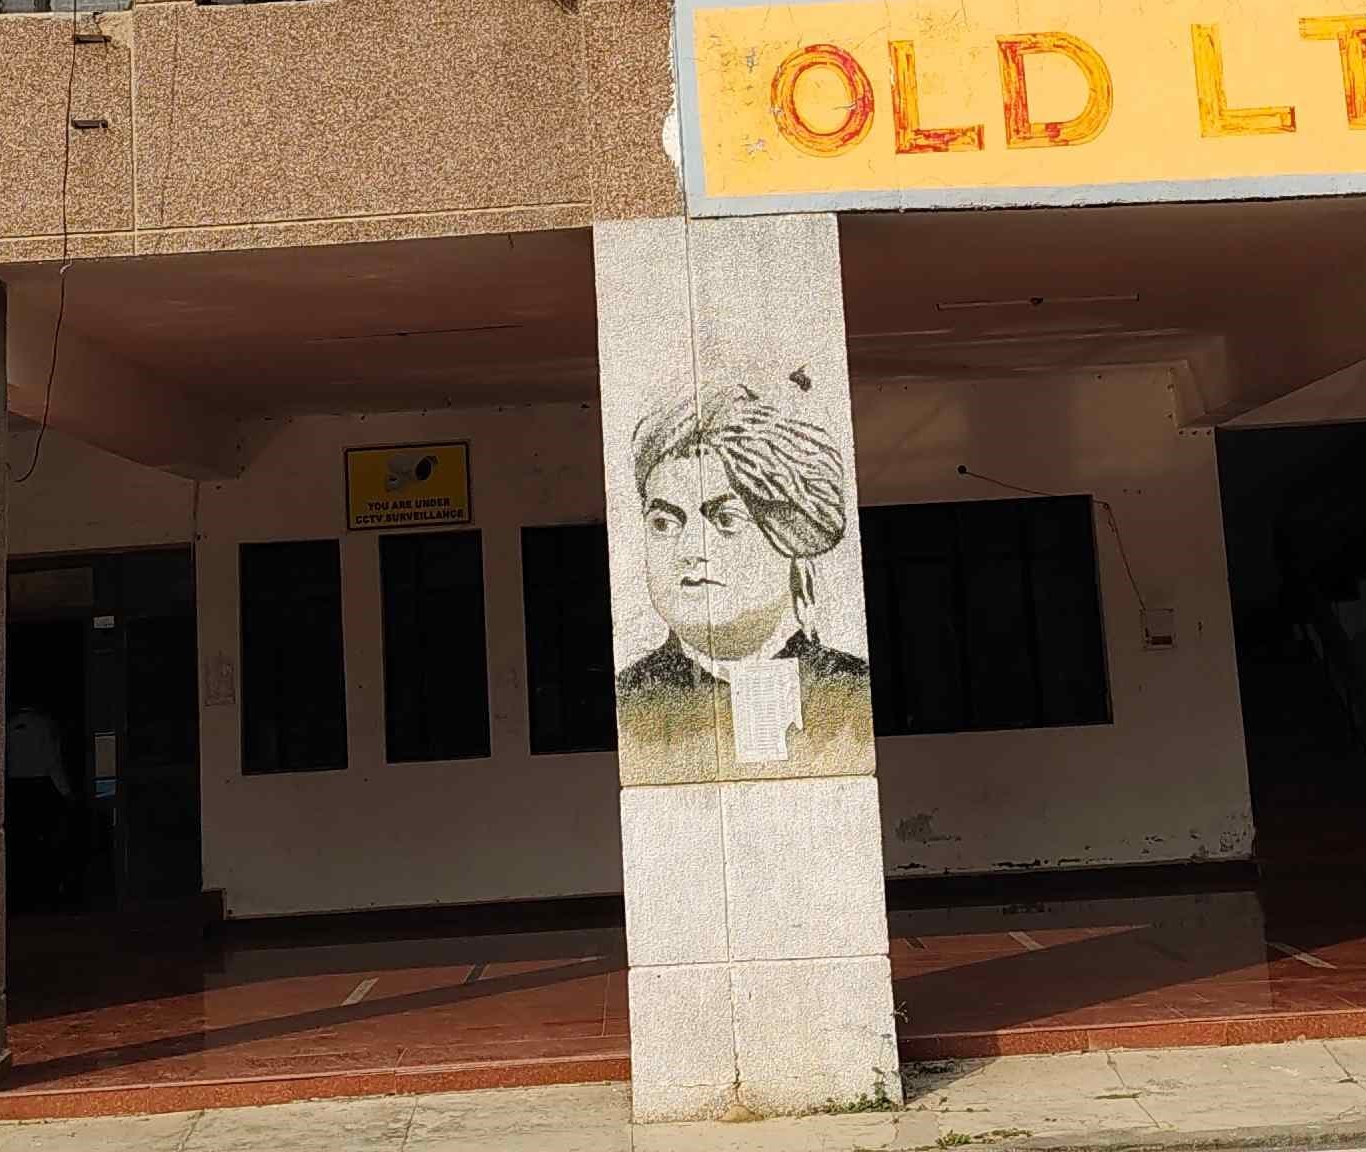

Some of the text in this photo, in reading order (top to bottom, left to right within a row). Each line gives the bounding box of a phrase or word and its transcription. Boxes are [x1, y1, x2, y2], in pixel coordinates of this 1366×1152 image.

[769, 31, 1115, 158] OLD
[367, 497, 450, 512] YOU ARE UNDER
[355, 509, 464, 525] CCTV SURVEILLANCE
